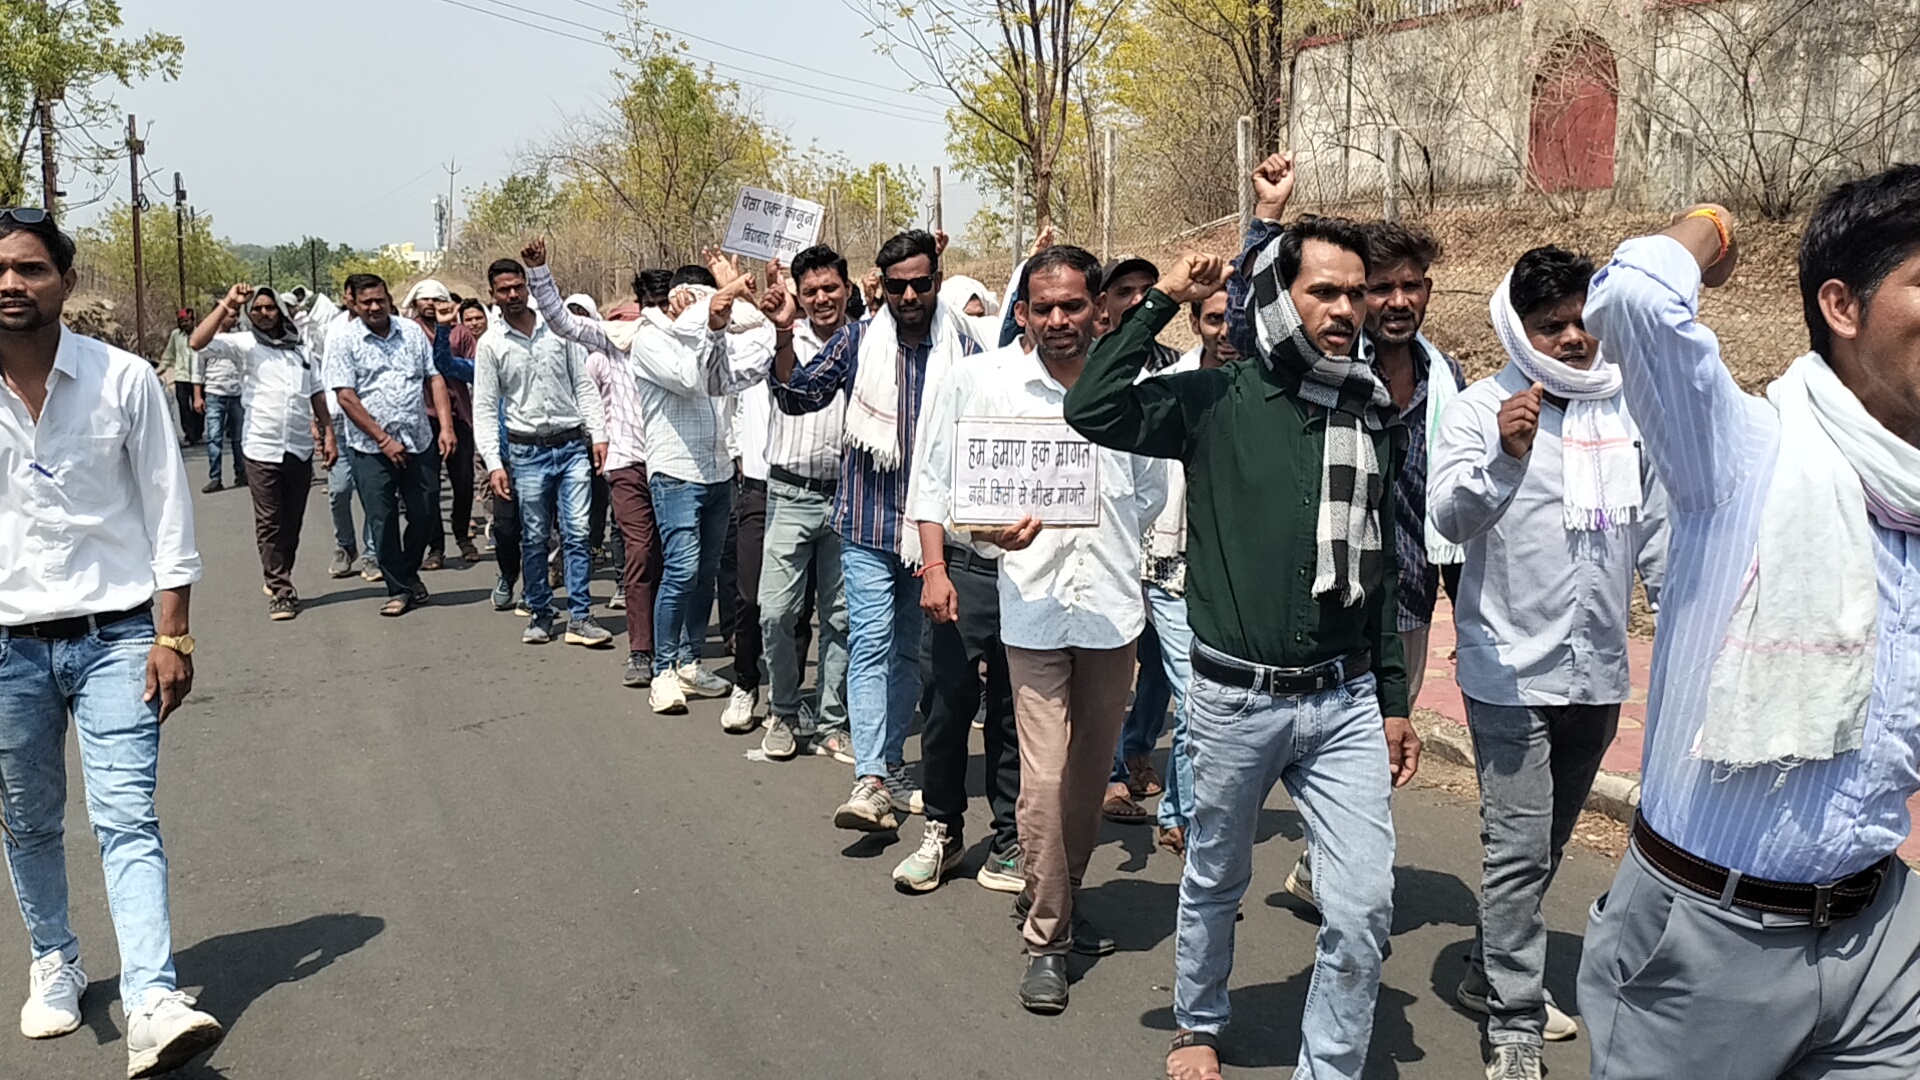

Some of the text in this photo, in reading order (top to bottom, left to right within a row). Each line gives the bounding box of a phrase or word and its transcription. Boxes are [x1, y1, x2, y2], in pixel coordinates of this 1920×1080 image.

[785, 206, 816, 230] कानून
[968, 438, 987, 469] हम
[992, 439, 1027, 469] हमारा
[1031, 440, 1051, 471] हक
[968, 477, 1087, 507] नहीं किसी से भीख मांगते
